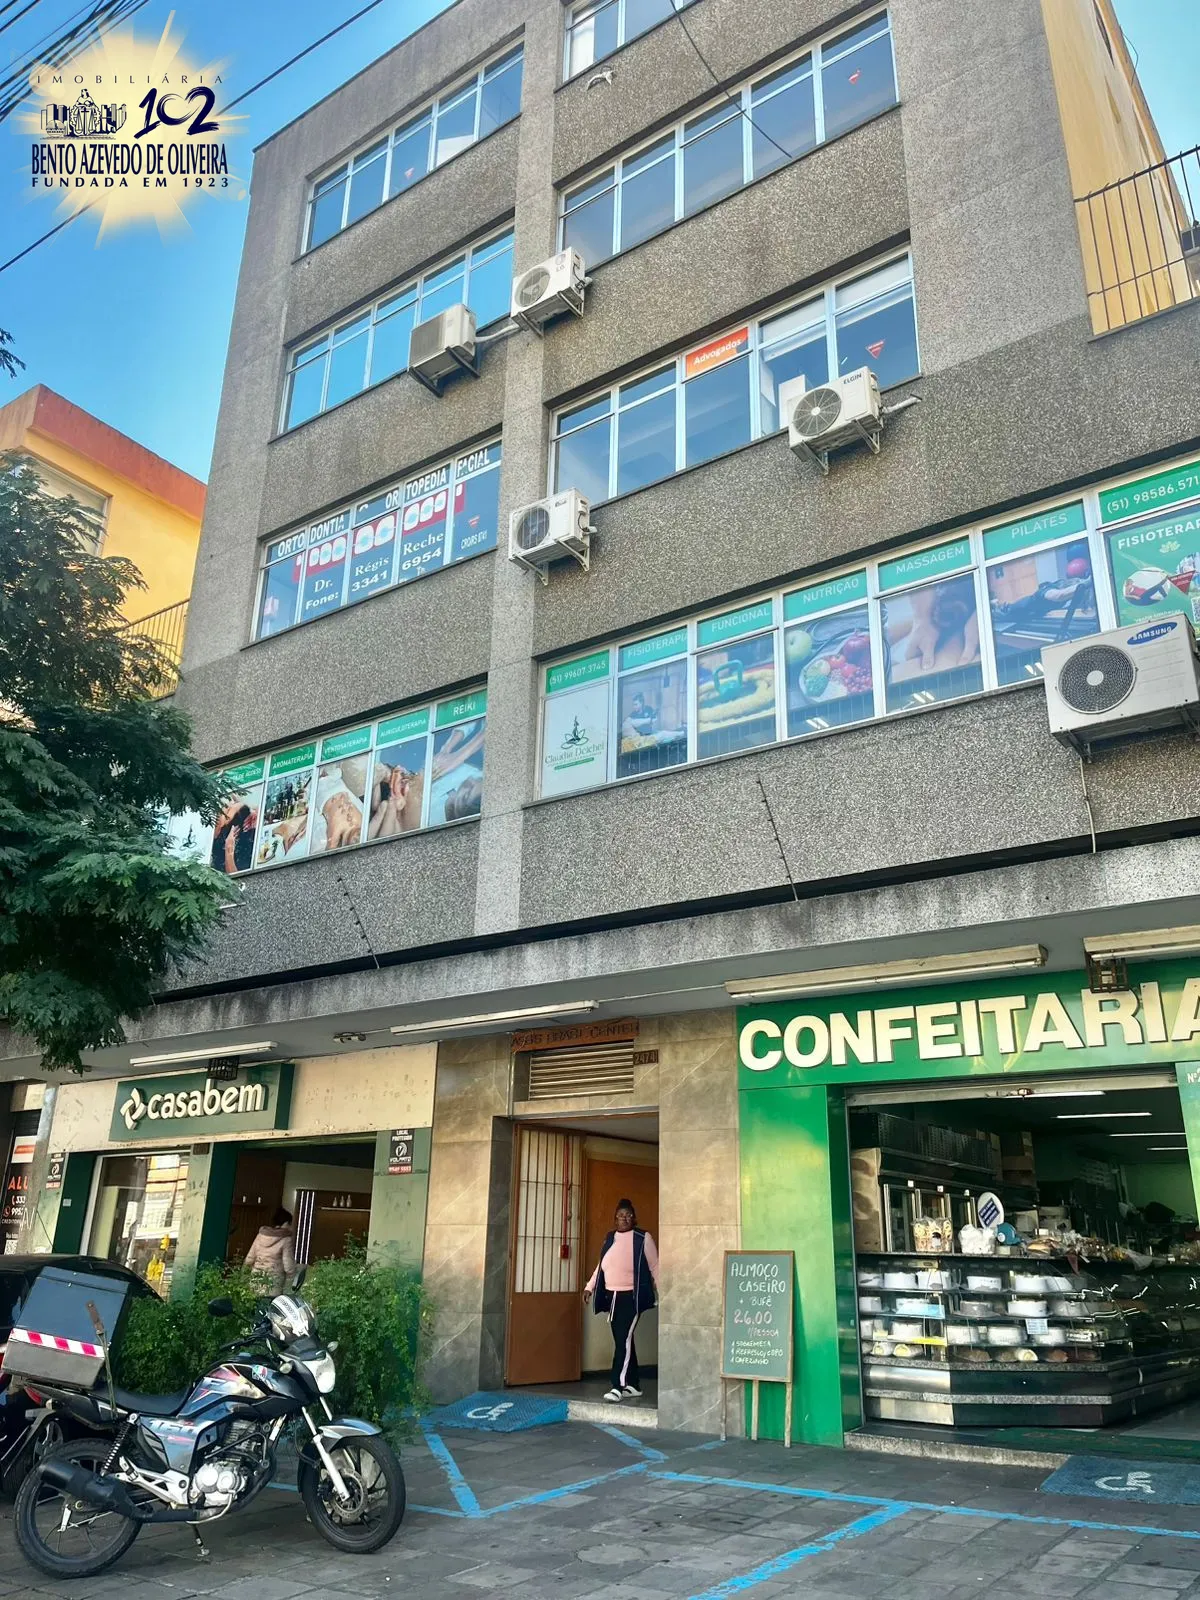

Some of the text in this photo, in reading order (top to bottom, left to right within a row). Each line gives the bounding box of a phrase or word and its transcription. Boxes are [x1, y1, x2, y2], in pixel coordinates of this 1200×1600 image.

[693, 340, 743, 365] Advogados
[843, 372, 862, 385] ELGIN
[277, 532, 305, 557] ORTO
[310, 514, 345, 544] DONTIA
[385, 489, 400, 509] OR
[406, 467, 447, 500] TOPEDIA
[1107, 497, 1129, 513] (51)
[1011, 513, 1068, 539] PILATES
[314, 578, 333, 593] Dr.
[354, 555, 390, 577] Régis
[403, 533, 443, 556] Reche
[895, 544, 966, 576] MASSAGEM
[305, 592, 340, 611] Fone:
[351, 570, 388, 592] 3341
[402, 547, 442, 571] 6954
[802, 577, 860, 605] NUTRIÇÃO
[711, 607, 770, 632] FUNCIONAL
[1132, 626, 1172, 641] SAMSUNG
[452, 702, 476, 717] REIKI
[272, 753, 313, 769] AROMATERAPIA
[147, 1078, 264, 1120] casabem
[731, 1261, 779, 1281] ALMOÇO
[739, 1279, 786, 1294] CASEIRO
[751, 1295, 772, 1307] BUFÊ
